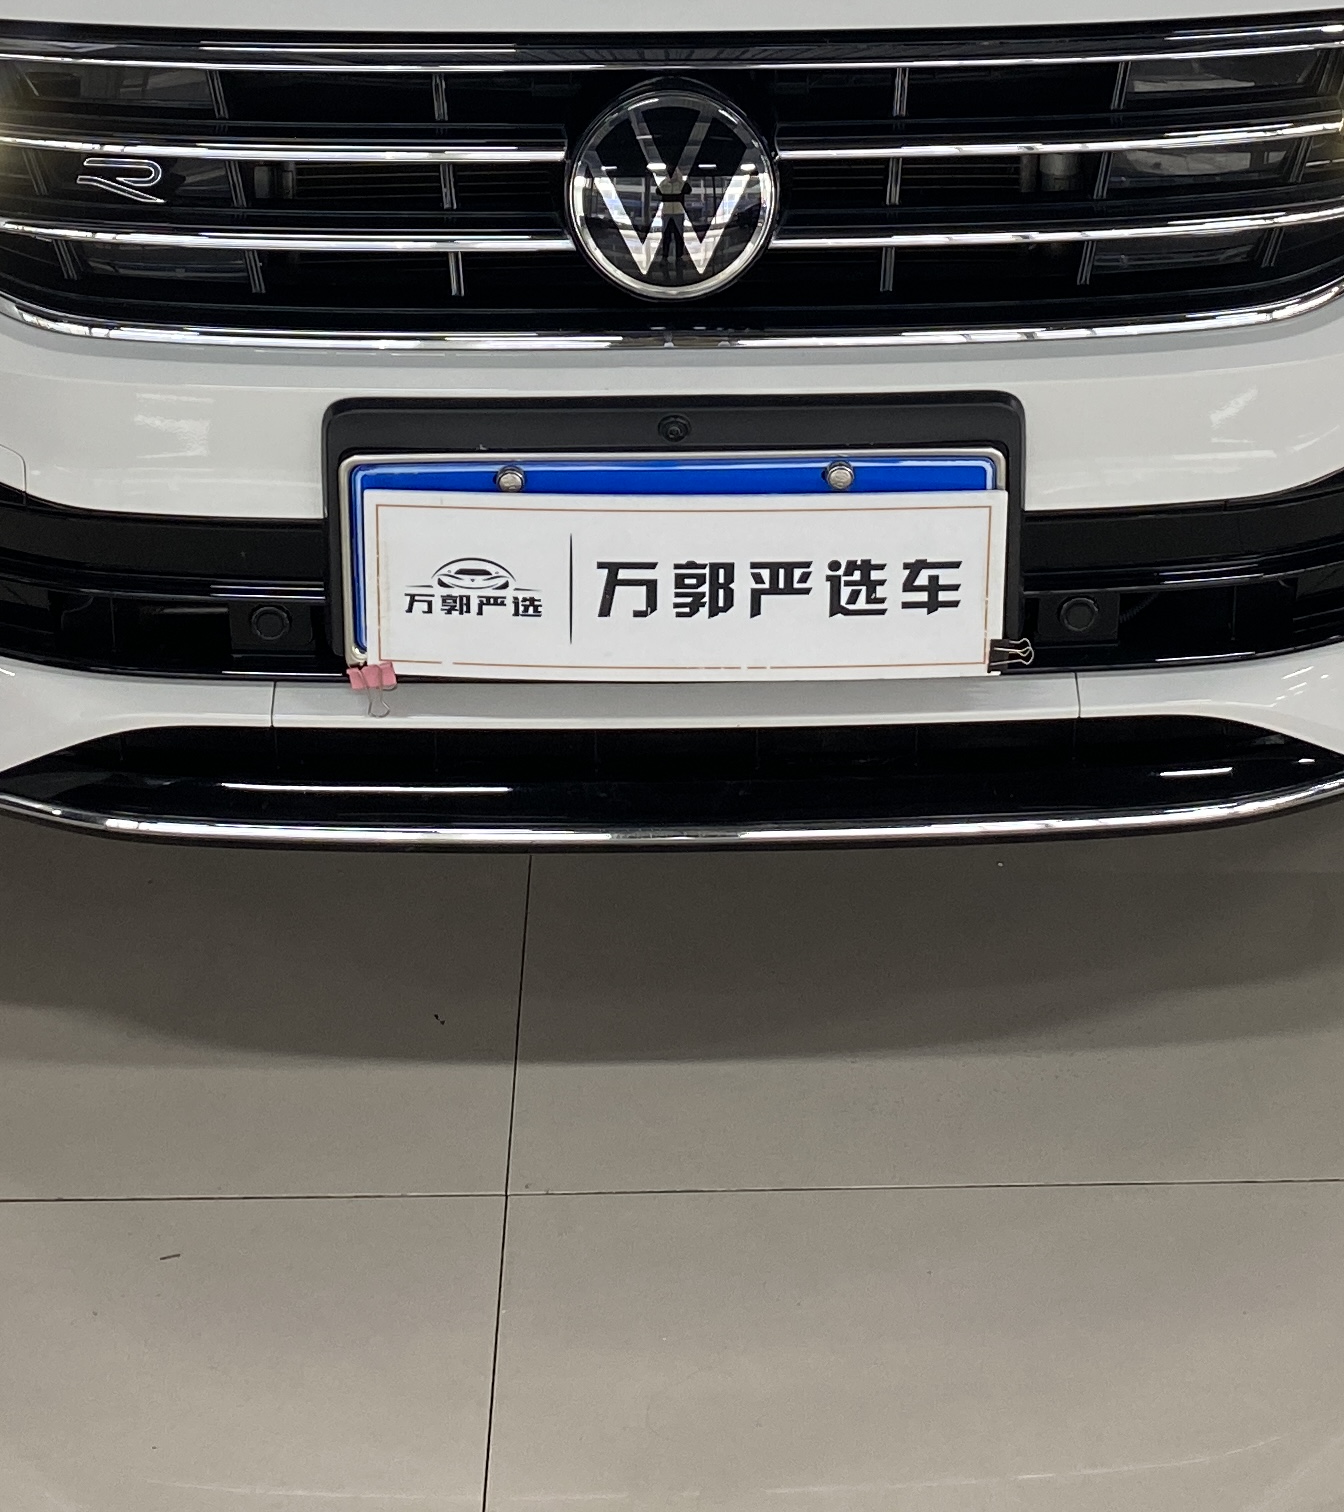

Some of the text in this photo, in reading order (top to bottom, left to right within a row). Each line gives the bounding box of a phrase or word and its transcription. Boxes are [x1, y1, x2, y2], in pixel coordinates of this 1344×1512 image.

[404, 592, 543, 617] 万郭严选
[596, 558, 963, 619] 万郭严选车
